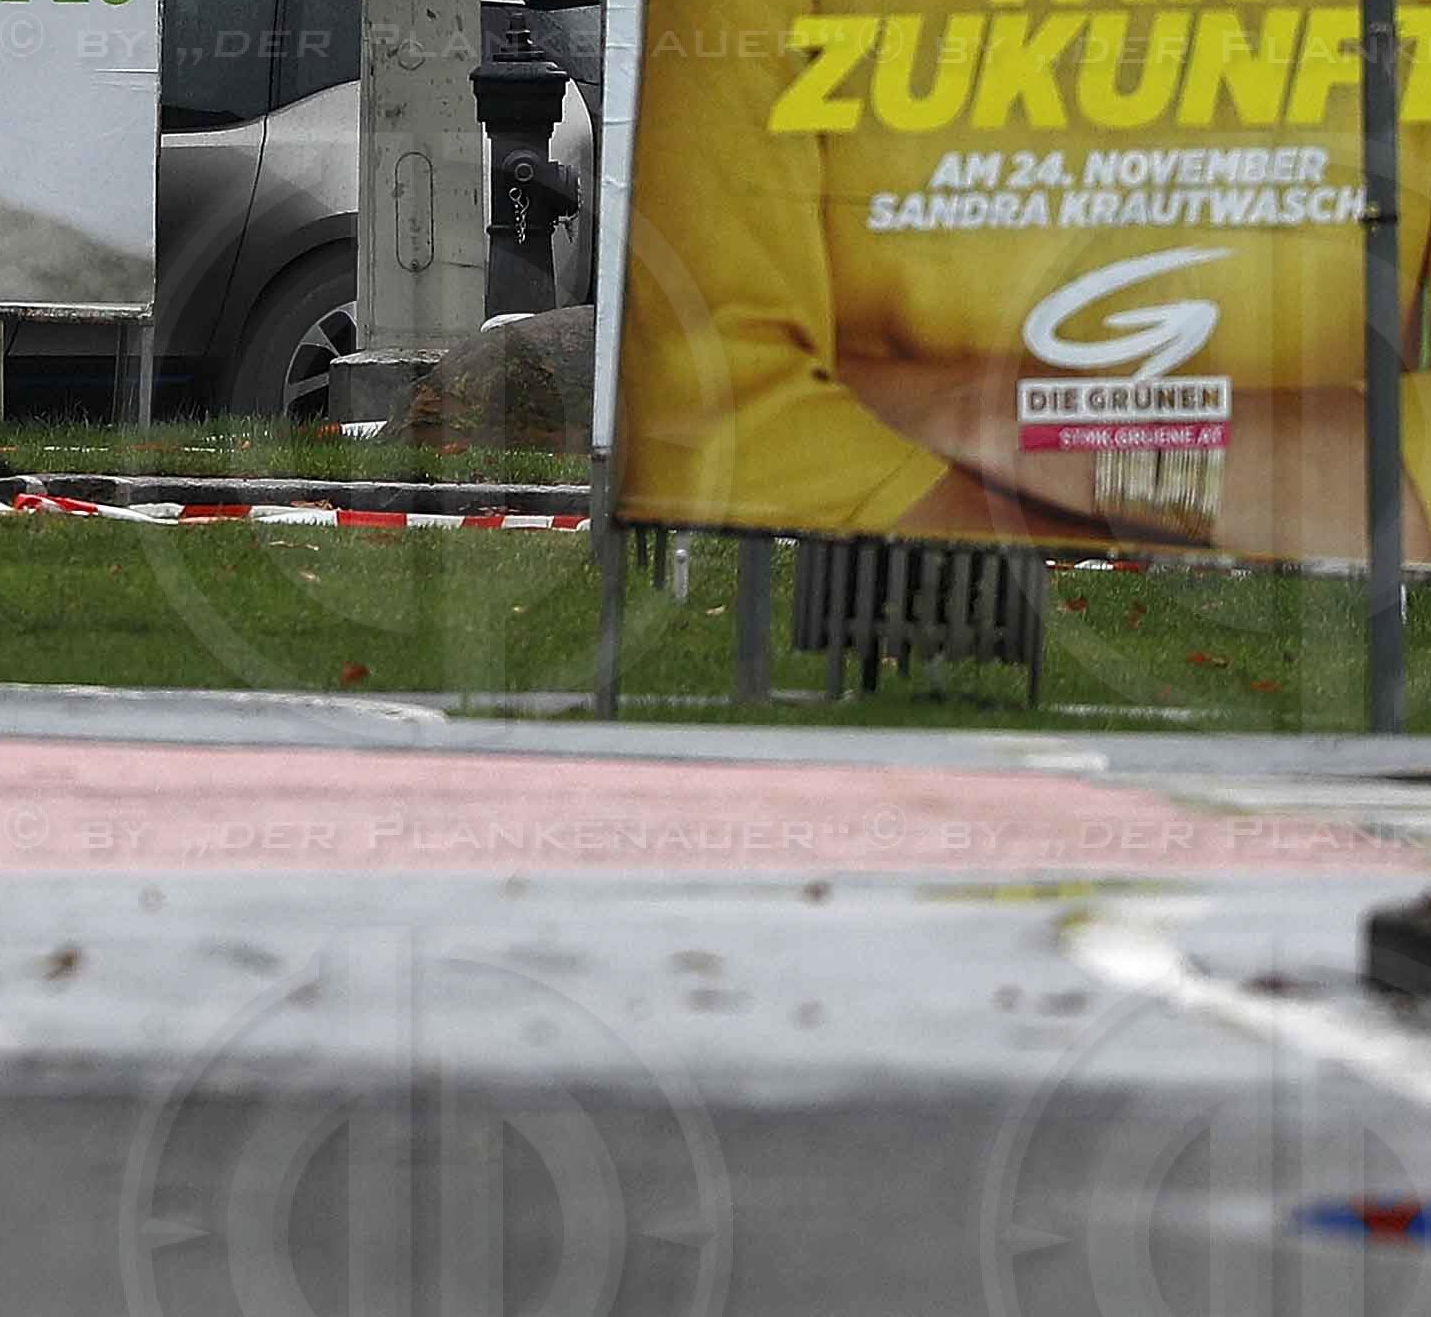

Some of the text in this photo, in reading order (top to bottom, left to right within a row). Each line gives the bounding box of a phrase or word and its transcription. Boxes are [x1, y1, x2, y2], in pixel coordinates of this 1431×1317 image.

[929, 146, 1330, 188] AM 24. NOVEMBER
[867, 184, 1371, 230] SANDRA KRAUTWASCH
[1029, 380, 1220, 411] DIE GRÜNEN
